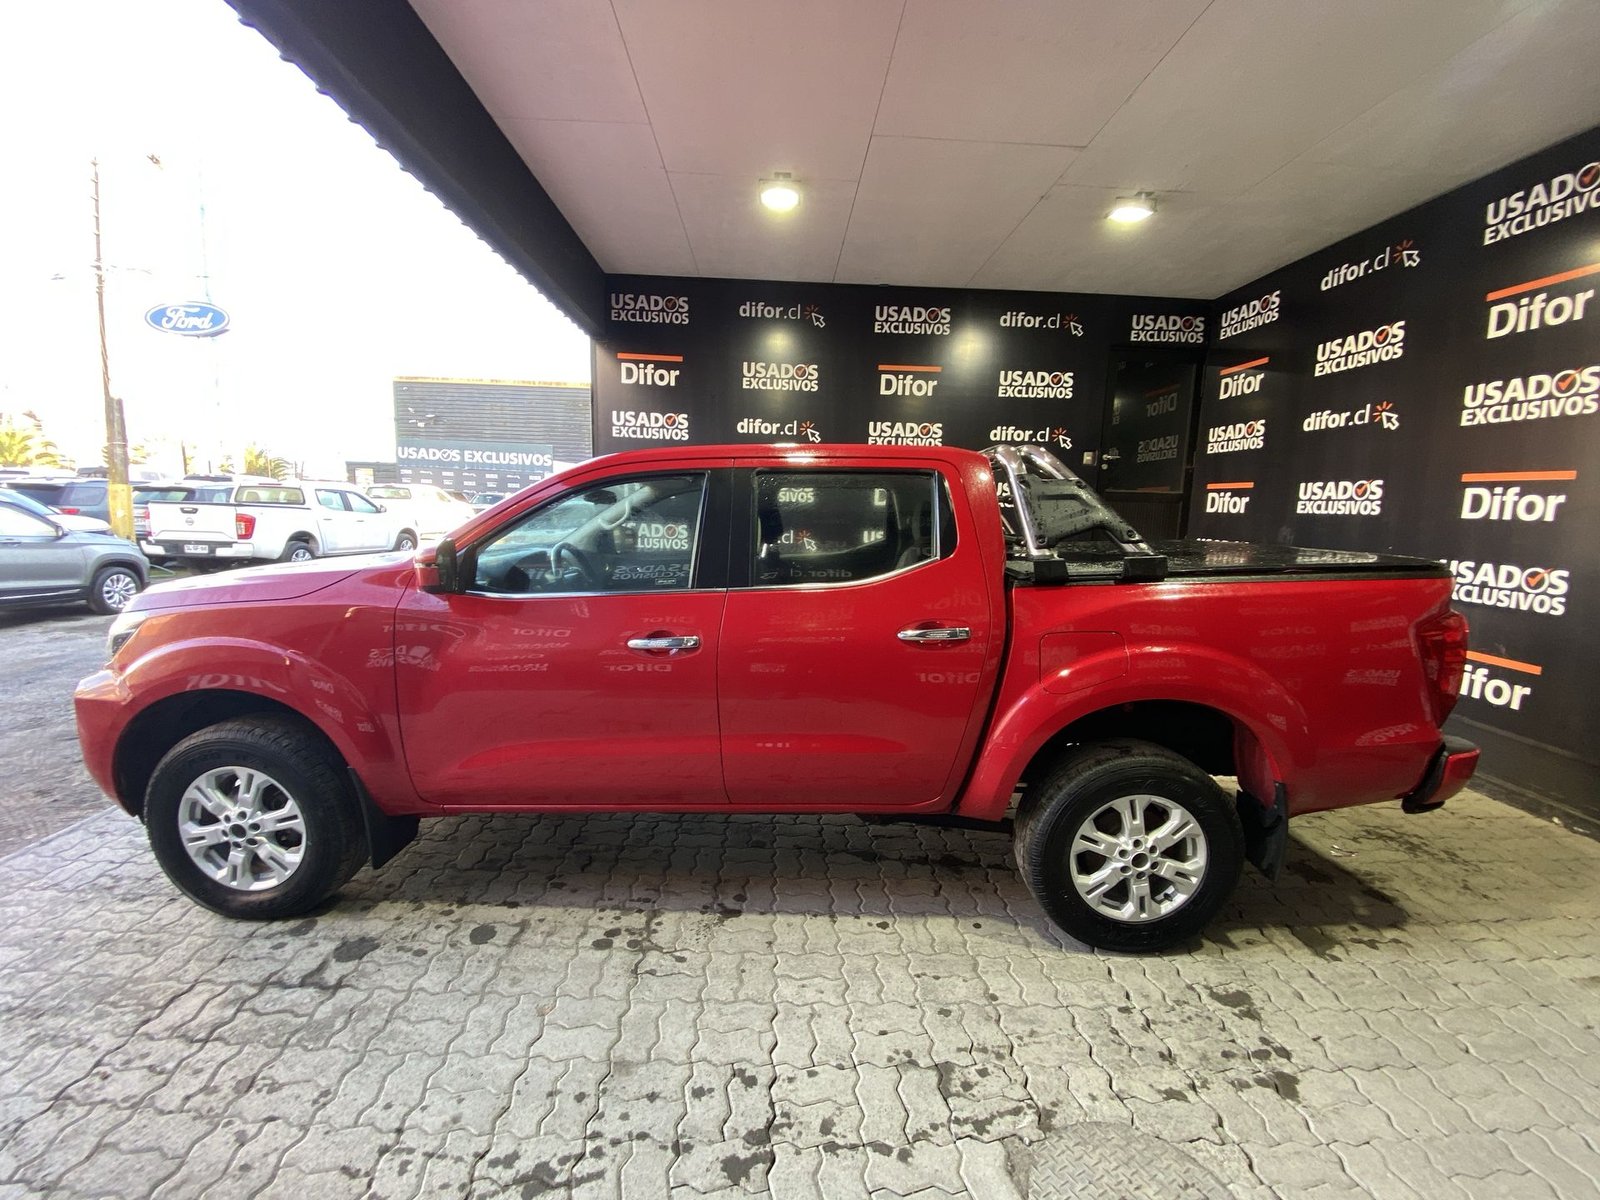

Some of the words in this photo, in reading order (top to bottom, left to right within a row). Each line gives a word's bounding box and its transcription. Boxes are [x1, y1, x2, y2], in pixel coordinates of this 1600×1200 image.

[1486, 162, 1600, 225] USADO
[1321, 247, 1390, 291] difor.cl
[611, 293, 689, 312] USADOS
[739, 302, 801, 320] difor.cl
[1221, 290, 1280, 328] USADOS
[161, 306, 214, 329] Ford
[611, 309, 689, 325] EXCLUSIVOS
[875, 306, 950, 323] USADOS
[1000, 312, 1060, 330] difor.cl
[1132, 315, 1205, 332] USADOS
[1487, 289, 1594, 340] Difor
[874, 322, 950, 336] EXCLUSIVOS
[1219, 310, 1279, 340] EXCLUSIVOS
[1130, 330, 1204, 344] EXCLUSIVOS
[1317, 321, 1405, 362] USADOS
[1314, 343, 1403, 377] EXCLUSIVOS
[620, 362, 680, 387] Difor
[742, 362, 818, 380] USADOS
[999, 371, 1074, 388] USADOS
[742, 378, 819, 392] EXCLUSIVOS
[880, 374, 938, 397] Difor
[998, 386, 1073, 400] EXCLUSIVOS
[1219, 373, 1264, 400] Difor
[1464, 366, 1600, 408] USADOS
[1303, 404, 1370, 432] difor.cl
[1460, 393, 1598, 426] EXCLUSIVOS
[612, 411, 688, 429] USADOS
[737, 418, 797, 436] difor.cl
[612, 427, 689, 441] EXCLUSIVOS
[868, 421, 943, 439] USADOS
[990, 427, 1049, 443] difor.cl
[1209, 420, 1265, 442] USADOS
[1207, 436, 1263, 454] EXCLUSIVOS
[398, 447, 460, 462] USADOS
[464, 450, 552, 466] EXCLUSIVOS
[1299, 480, 1383, 500] USADOS
[1206, 493, 1249, 514] Difor
[1297, 500, 1381, 515] EXCLUSIVOS
[1461, 487, 1566, 522] Difor
[1460, 664, 1531, 710] ifor
